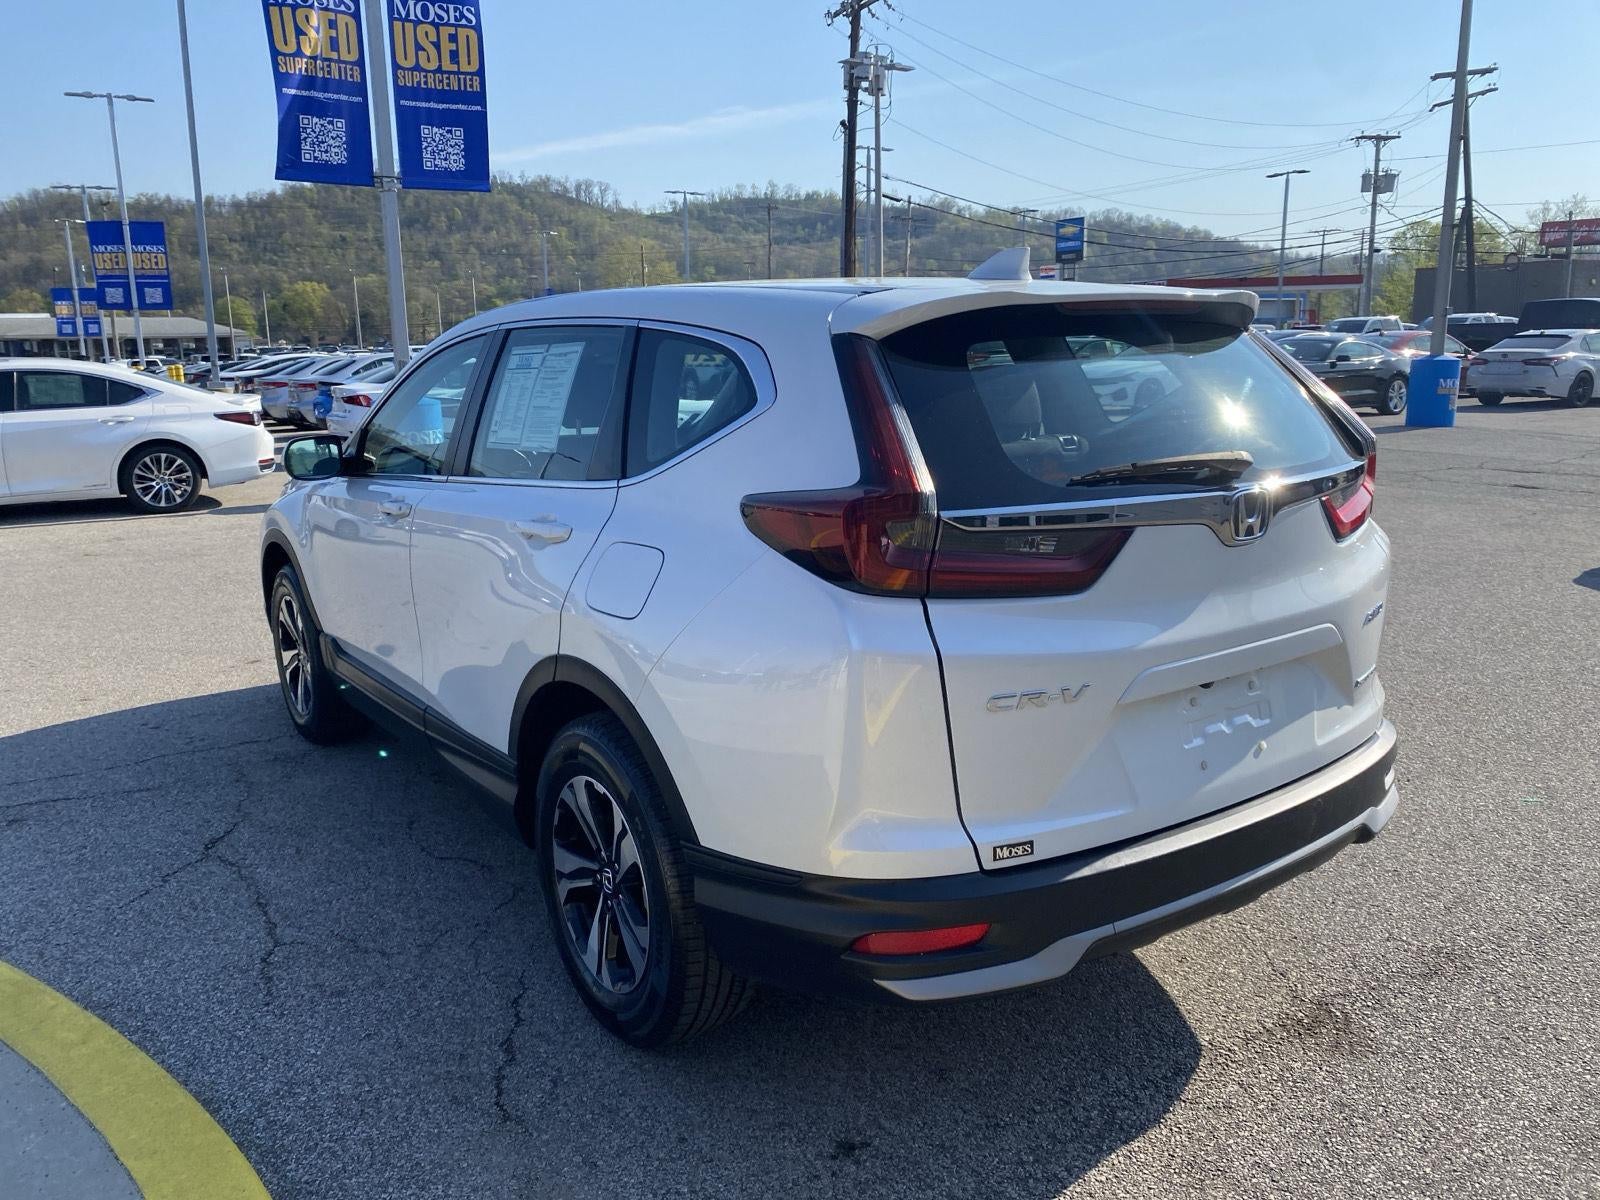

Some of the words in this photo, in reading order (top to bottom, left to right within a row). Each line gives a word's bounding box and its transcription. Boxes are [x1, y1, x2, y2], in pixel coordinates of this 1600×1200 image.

[393, 0, 476, 25] MOSES
[268, 6, 359, 62] USED
[393, 21, 479, 73] USED
[277, 56, 361, 83] SUPERCENTER
[397, 70, 480, 92] SUPERCENTER
[282, 87, 363, 102] mosesusedsupercenter.com
[400, 99, 482, 111] mosesusedsupercenter.com
[93, 245, 125, 253] MOSES
[132, 245, 165, 253] MOSES
[94, 253, 126, 269] USED
[133, 253, 166, 269] USED
[986, 683, 1093, 712] CR-V
[995, 843, 1031, 860] MOSES
